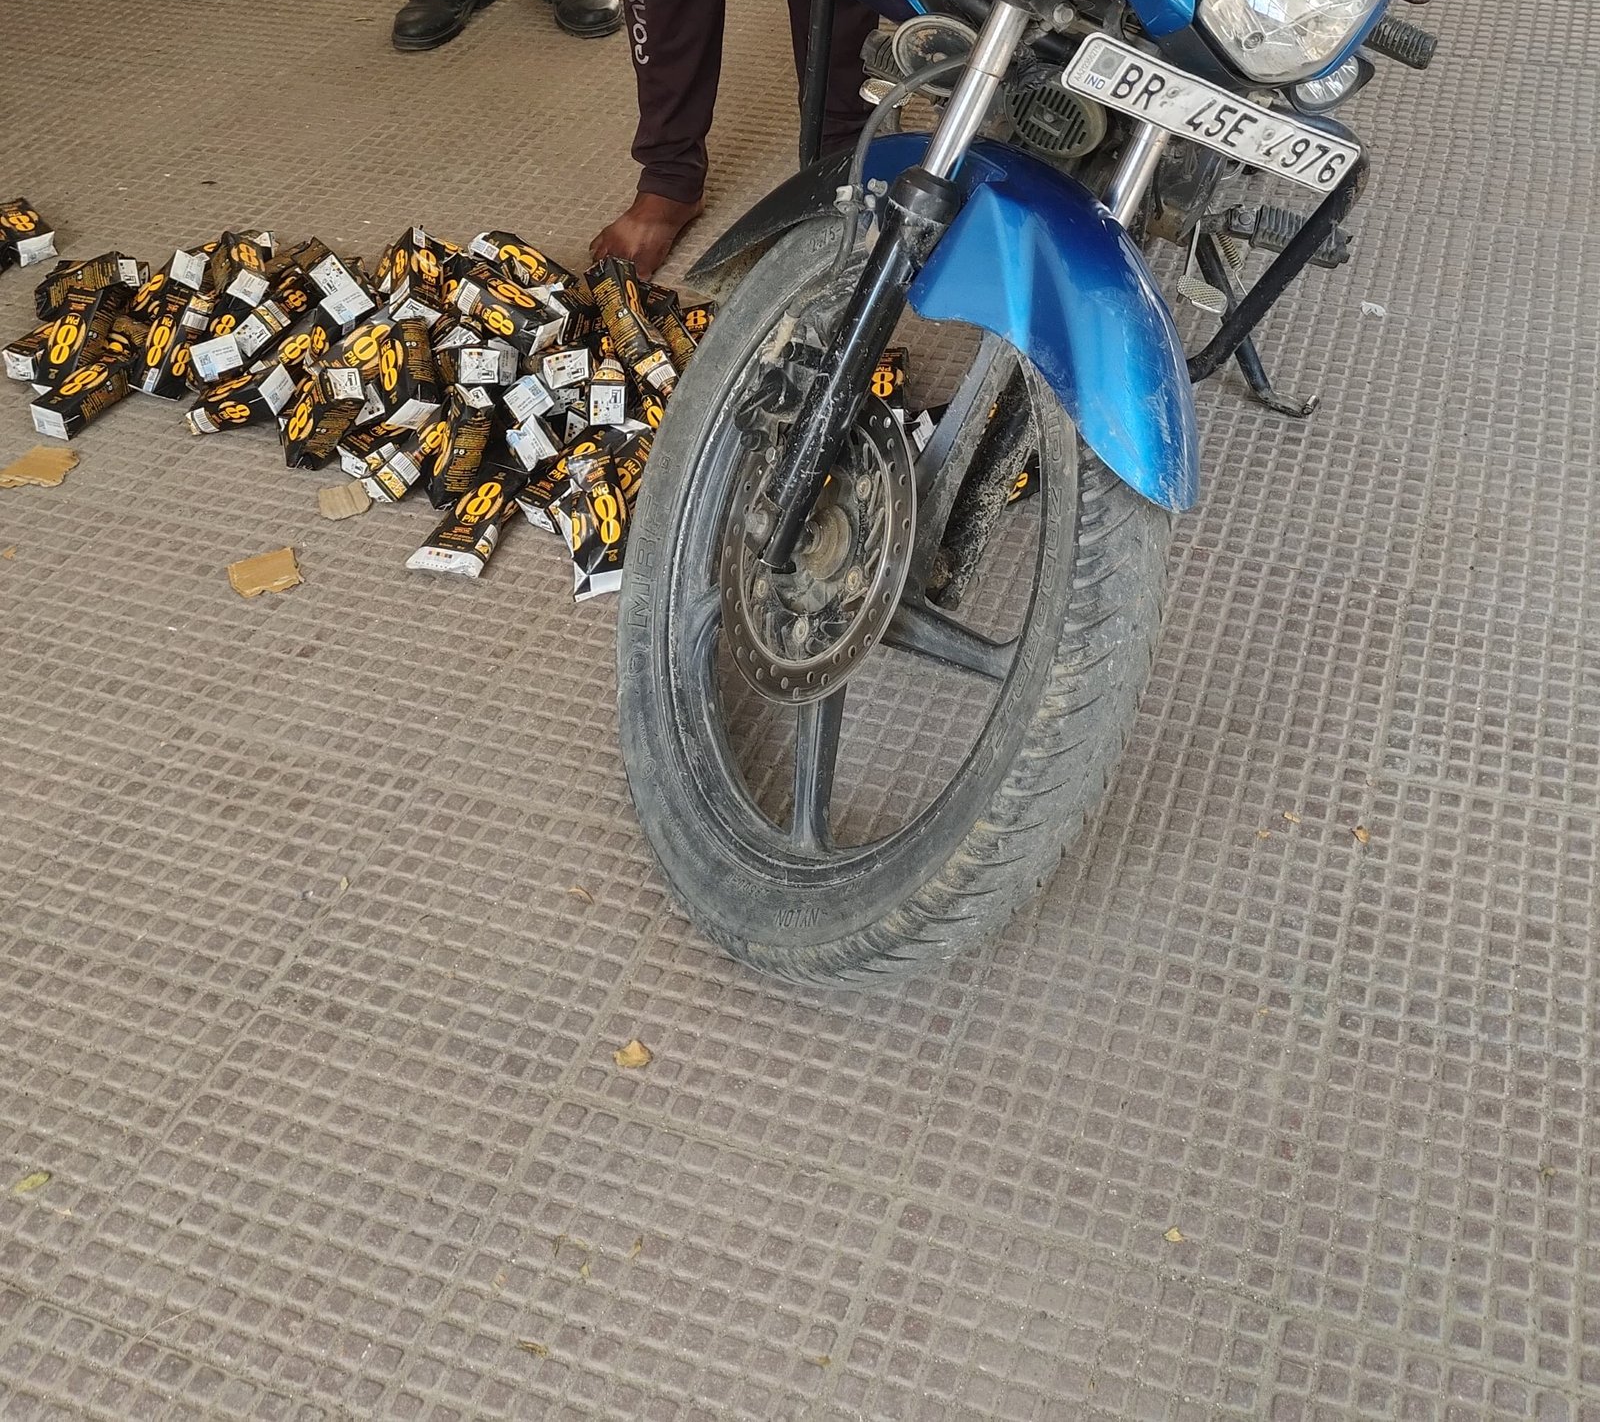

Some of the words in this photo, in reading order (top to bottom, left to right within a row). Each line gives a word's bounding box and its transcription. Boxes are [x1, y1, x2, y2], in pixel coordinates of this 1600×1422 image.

[1084, 74, 1106, 90] IND
[1110, 63, 1166, 110] BR
[1185, 98, 1259, 148] 45E
[1262, 132, 1346, 184] 4976
[9, 214, 36, 232] 8
[238, 242, 260, 267] 8
[418, 249, 439, 278] 8
[531, 266, 546, 281] PM
[288, 290, 307, 308] 8
[497, 283, 537, 308] 8
[65, 315, 81, 325] PM
[161, 317, 173, 326] PM
[482, 308, 492, 321] PM
[488, 311, 514, 335] 8
[685, 309, 708, 327] 8
[50, 324, 78, 364] 8
[146, 325, 170, 367] 8
[284, 334, 311, 359] 8
[353, 324, 391, 360] 8
[381, 339, 392, 354] PM
[278, 353, 289, 364] PM
[344, 350, 360, 367] PM
[381, 349, 398, 391] 8
[59, 370, 98, 395] 8
[871, 371, 894, 397] 8
[225, 404, 251, 419] 8
[288, 402, 308, 441] 8
[548, 469, 566, 481] PM
[623, 459, 640, 476] PM
[466, 482, 501, 515] 8
[595, 483, 610, 497] PM
[461, 514, 479, 524] PM
[594, 494, 621, 544] 8
[627, 493, 667, 629] MRF
[774, 907, 820, 928] NYLON
